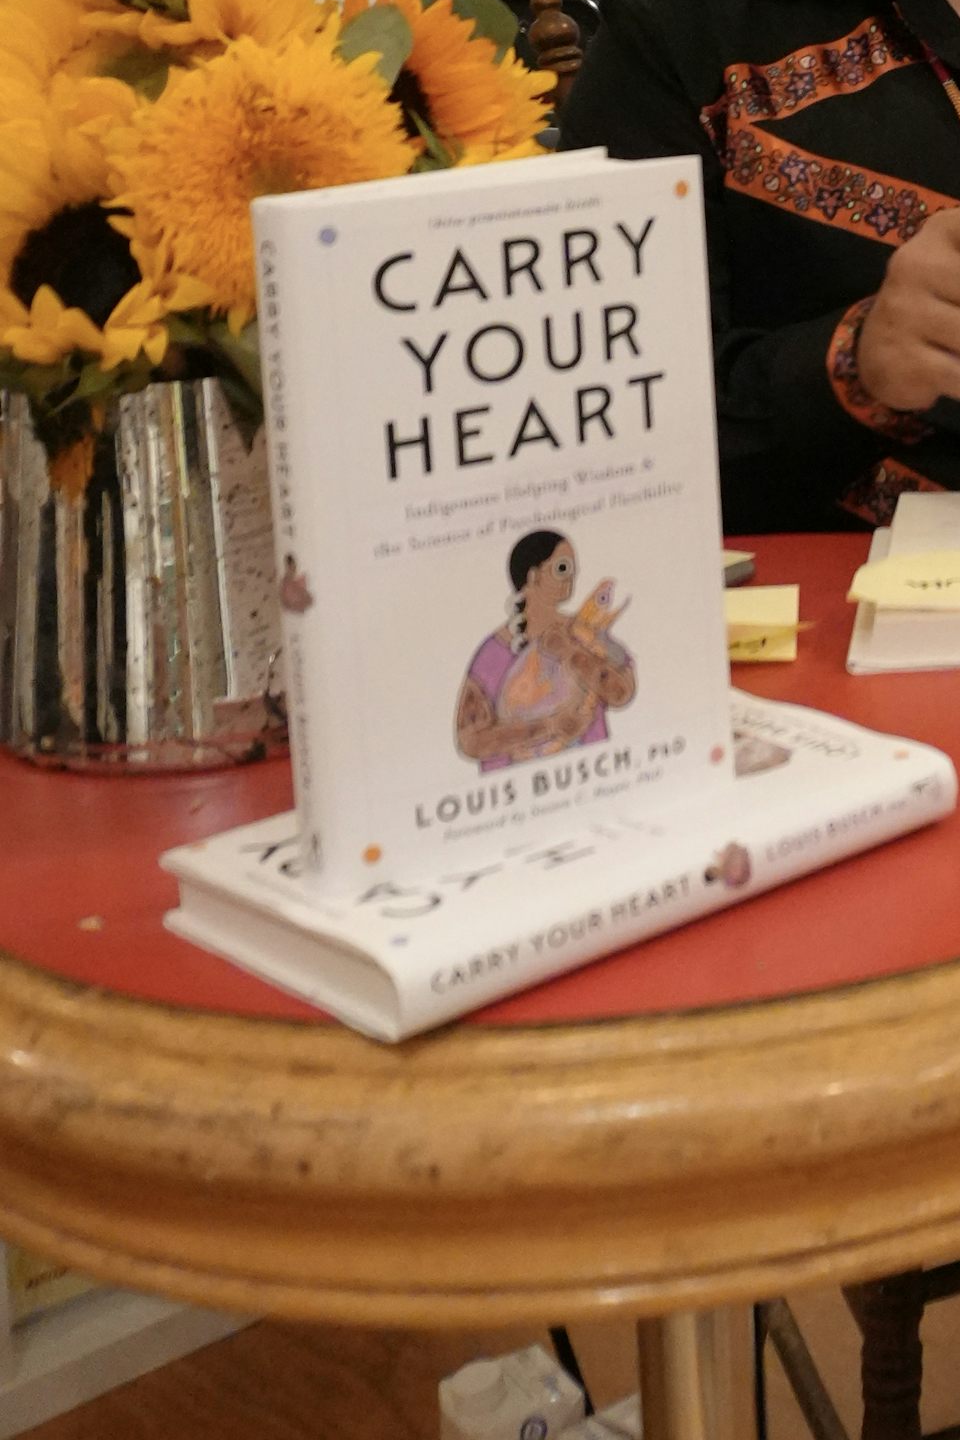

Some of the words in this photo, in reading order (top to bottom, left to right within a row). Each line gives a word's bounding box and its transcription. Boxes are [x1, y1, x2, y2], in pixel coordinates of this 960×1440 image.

[257, 238, 285, 339] CARRY
[372, 215, 656, 312] CARRY
[267, 348, 291, 433] YOUR
[402, 302, 641, 394] YOUR
[384, 371, 666, 481] HEART
[273, 440, 298, 539] HEART
[405, 492, 500, 522] Indigenous
[504, 477, 569, 504] Helping
[574, 461, 638, 486] Wisdom
[408, 529, 471, 553] Science
[499, 500, 605, 533] Psychological
[610, 479, 684, 509] Flexibility
[414, 773, 517, 830] LOUIS
[425, 937, 526, 998] CARRY
[527, 905, 608, 957] YOUR
[606, 870, 694, 924] HEART
